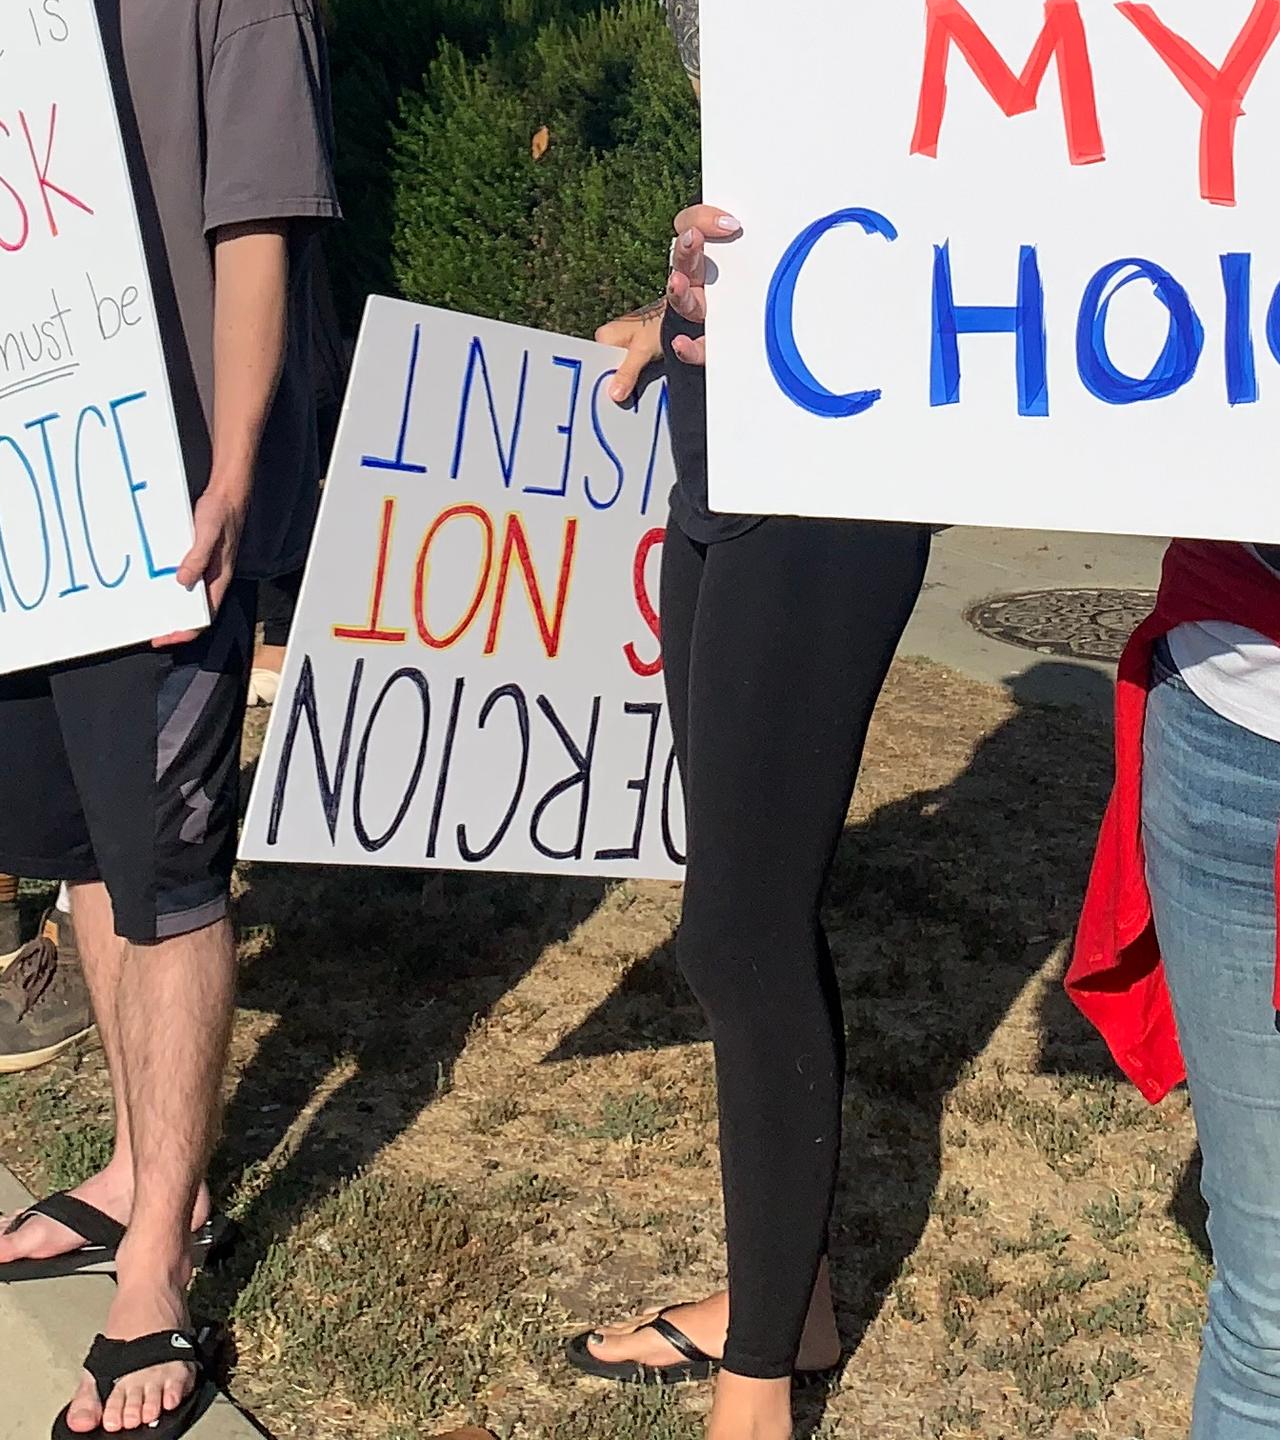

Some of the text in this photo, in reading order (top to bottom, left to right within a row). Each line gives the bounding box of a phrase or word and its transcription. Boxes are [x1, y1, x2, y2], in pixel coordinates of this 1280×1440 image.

[94, 271, 142, 344] be
[331, 497, 578, 658] NOT
[267, 654, 686, 865] ERCION
